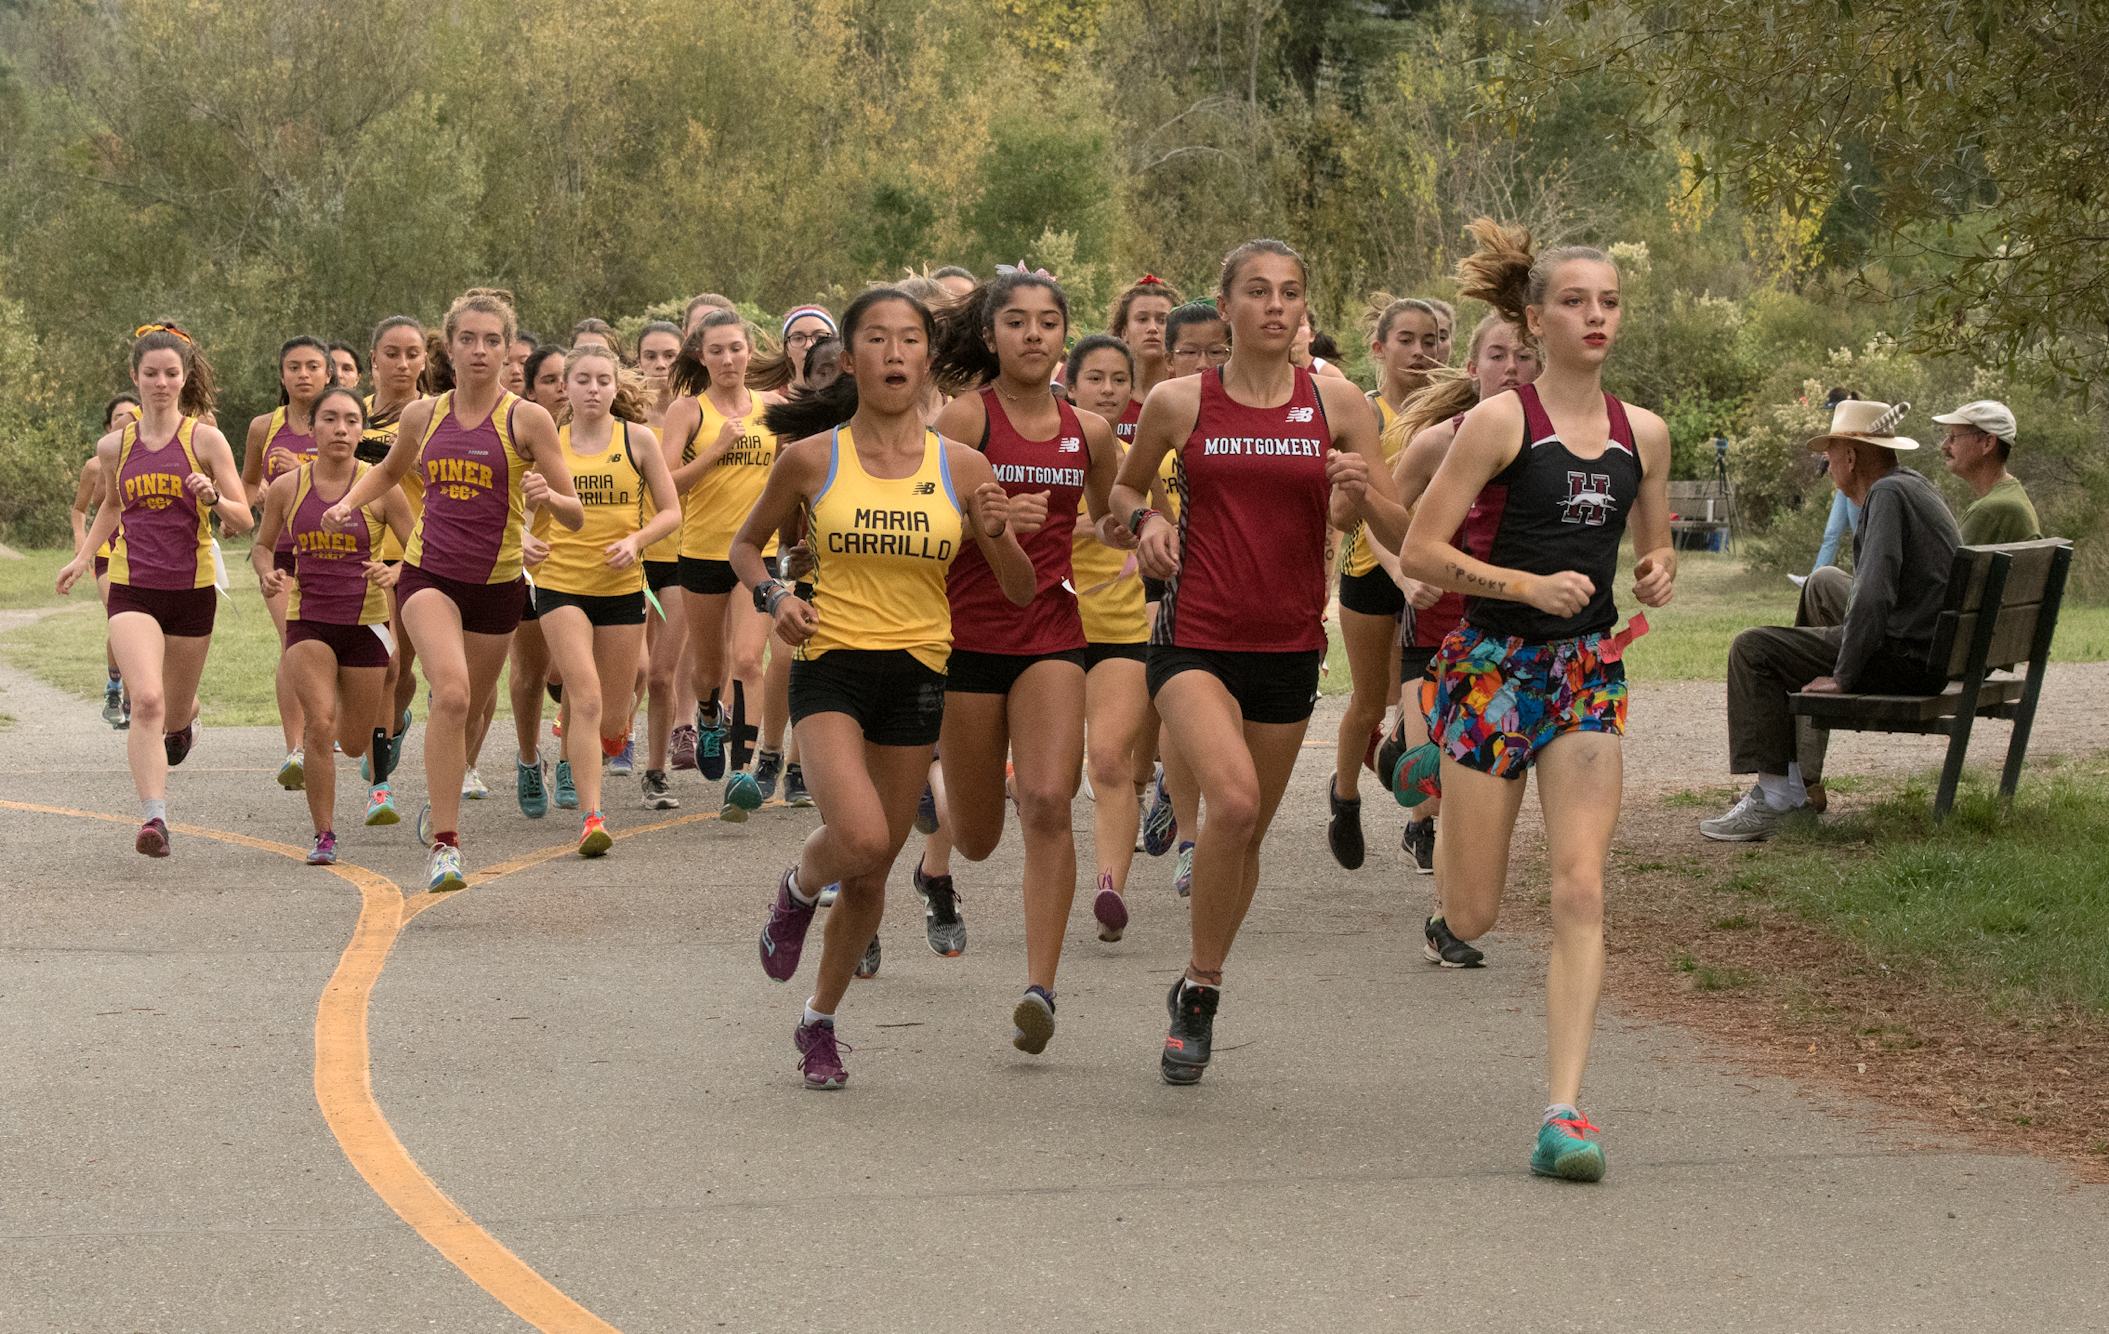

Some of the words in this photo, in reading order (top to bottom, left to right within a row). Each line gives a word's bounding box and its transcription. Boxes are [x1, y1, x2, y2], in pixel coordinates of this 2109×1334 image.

[715, 451, 771, 466] ARRILLO
[1203, 437, 1320, 457] MONTGOMERY
[124, 472, 183, 501] PINER
[428, 458, 493, 490] PINER
[991, 463, 1085, 487] MONTGOMERY
[1561, 470, 1610, 526] H
[854, 508, 930, 533] MARIA
[297, 530, 358, 553] PINER
[828, 532, 951, 561] CARRILLO
